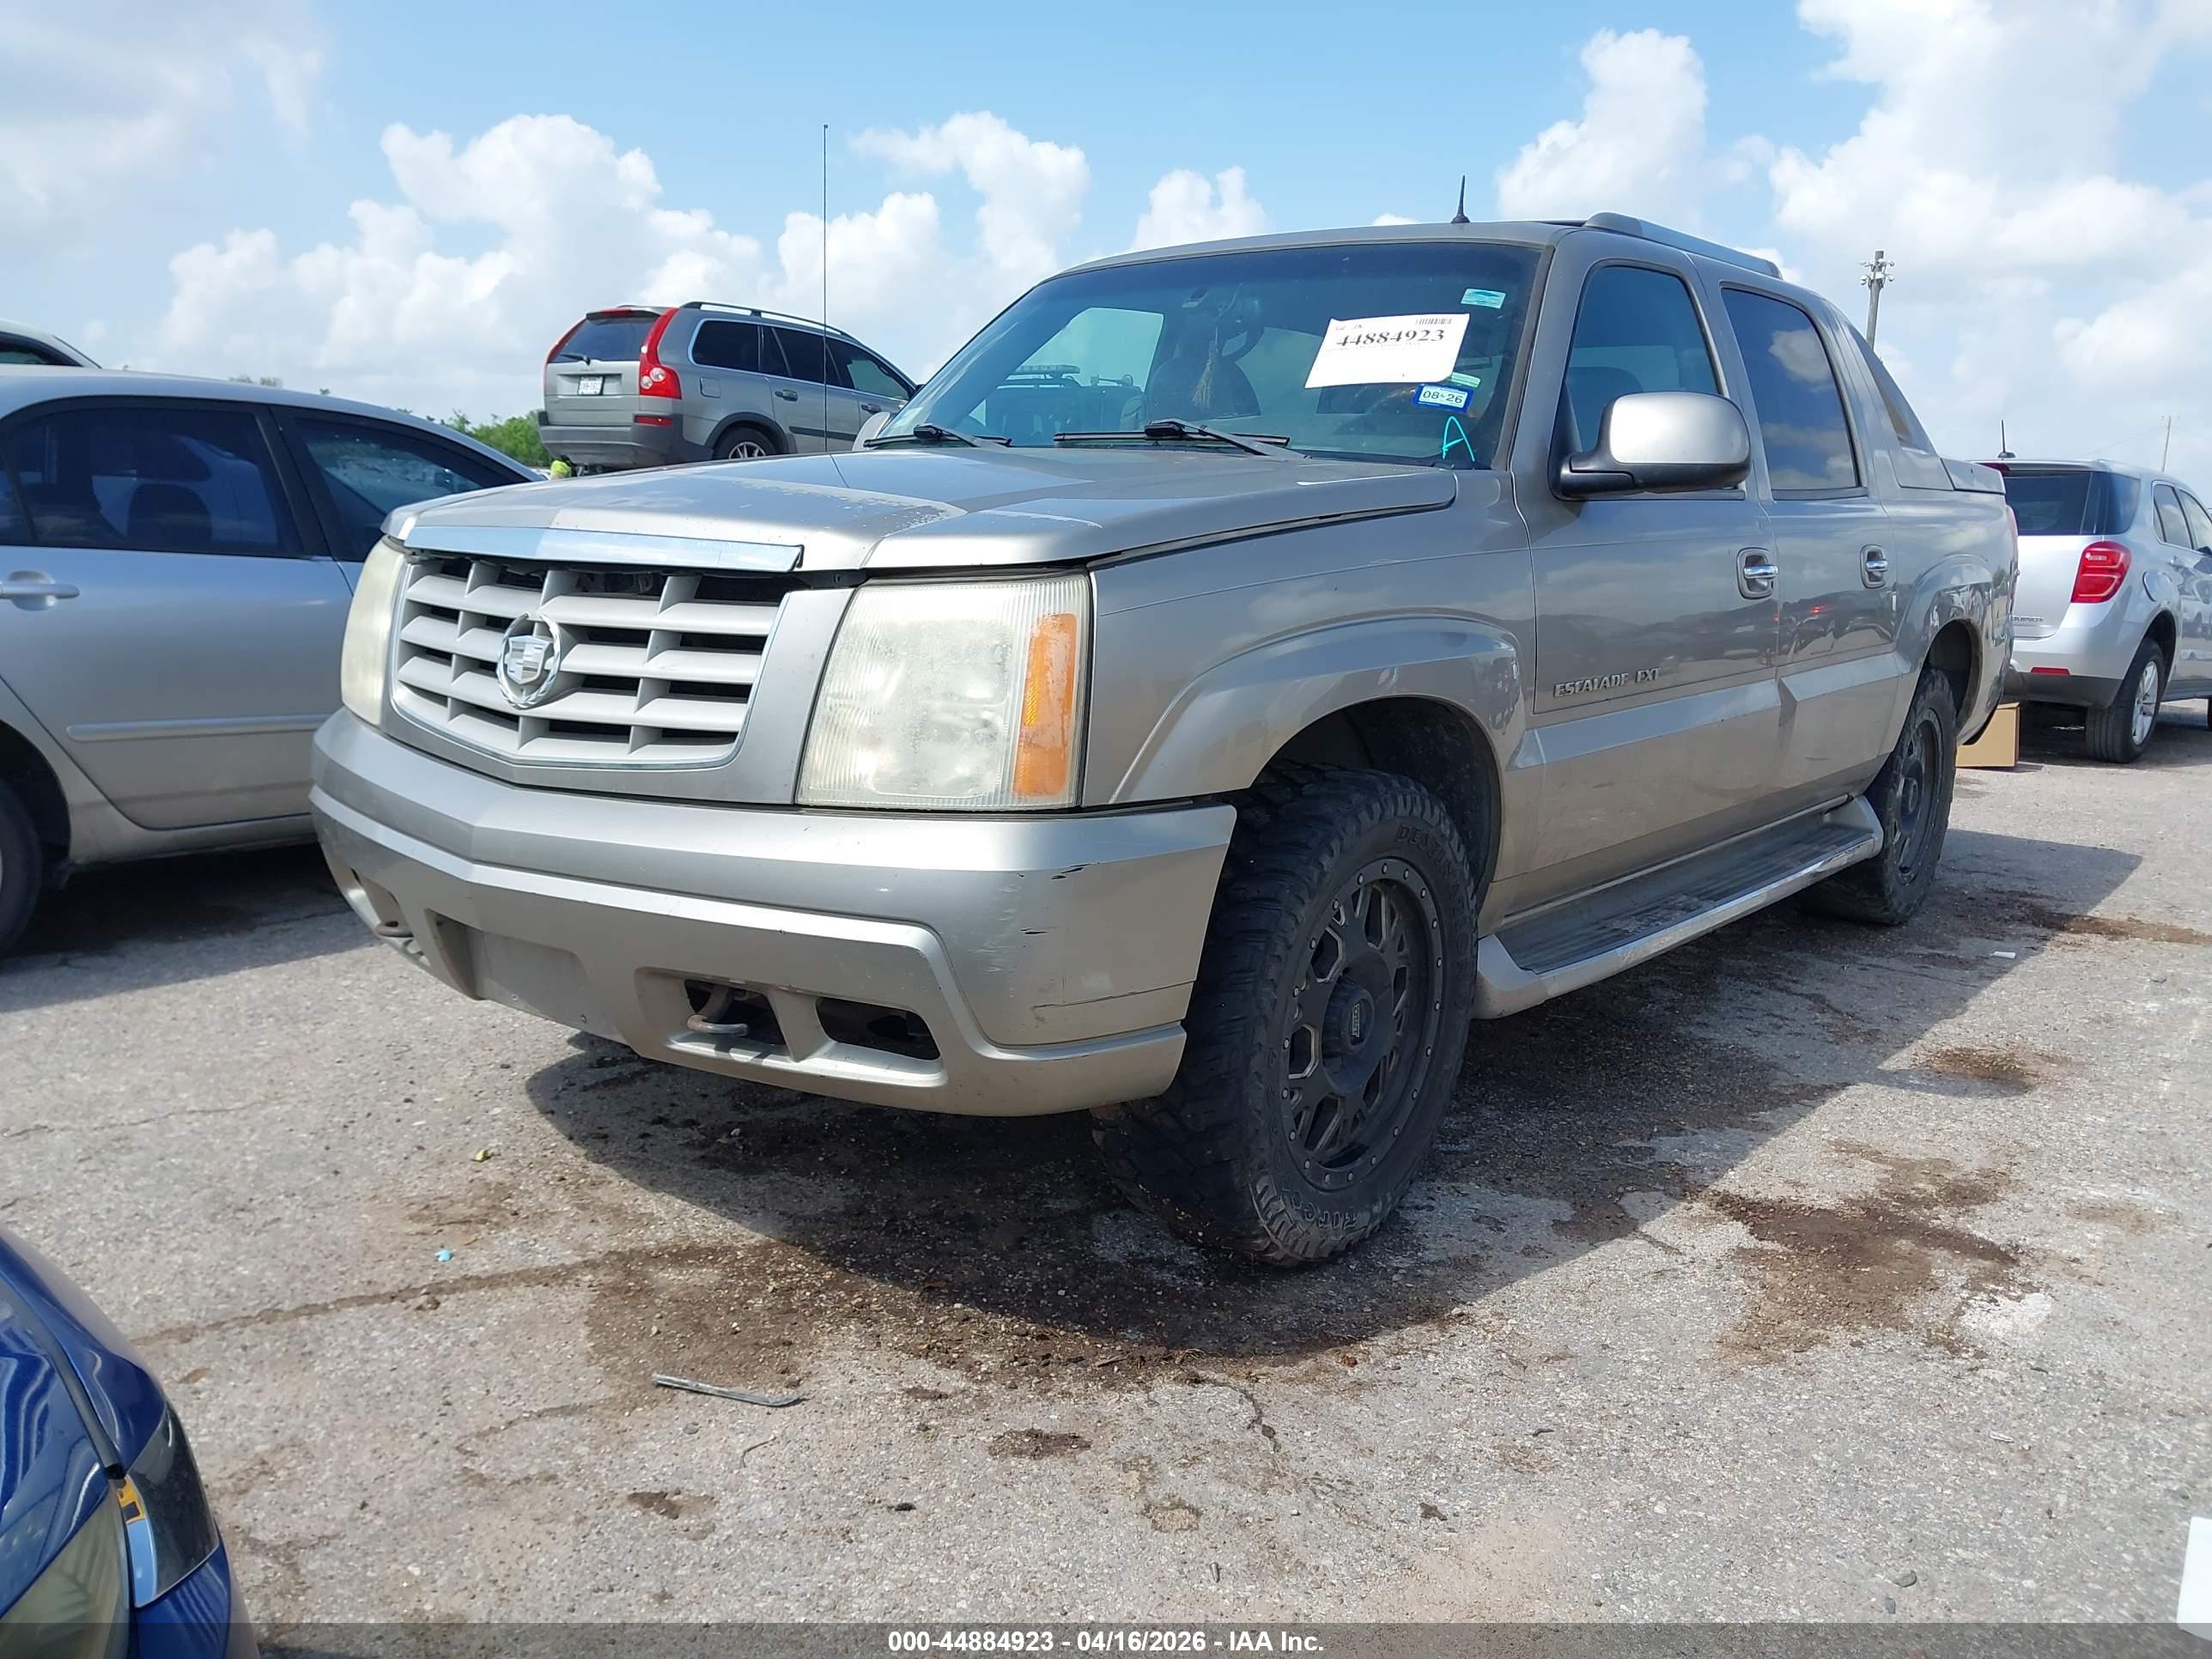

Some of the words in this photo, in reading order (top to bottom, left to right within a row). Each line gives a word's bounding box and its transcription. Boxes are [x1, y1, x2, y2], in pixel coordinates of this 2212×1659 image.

[1336, 329, 1445, 347] 44884923
[1442, 416, 1476, 462] A
[1553, 672, 1629, 697] ESCALADE
[1635, 667, 1662, 684] EXT
